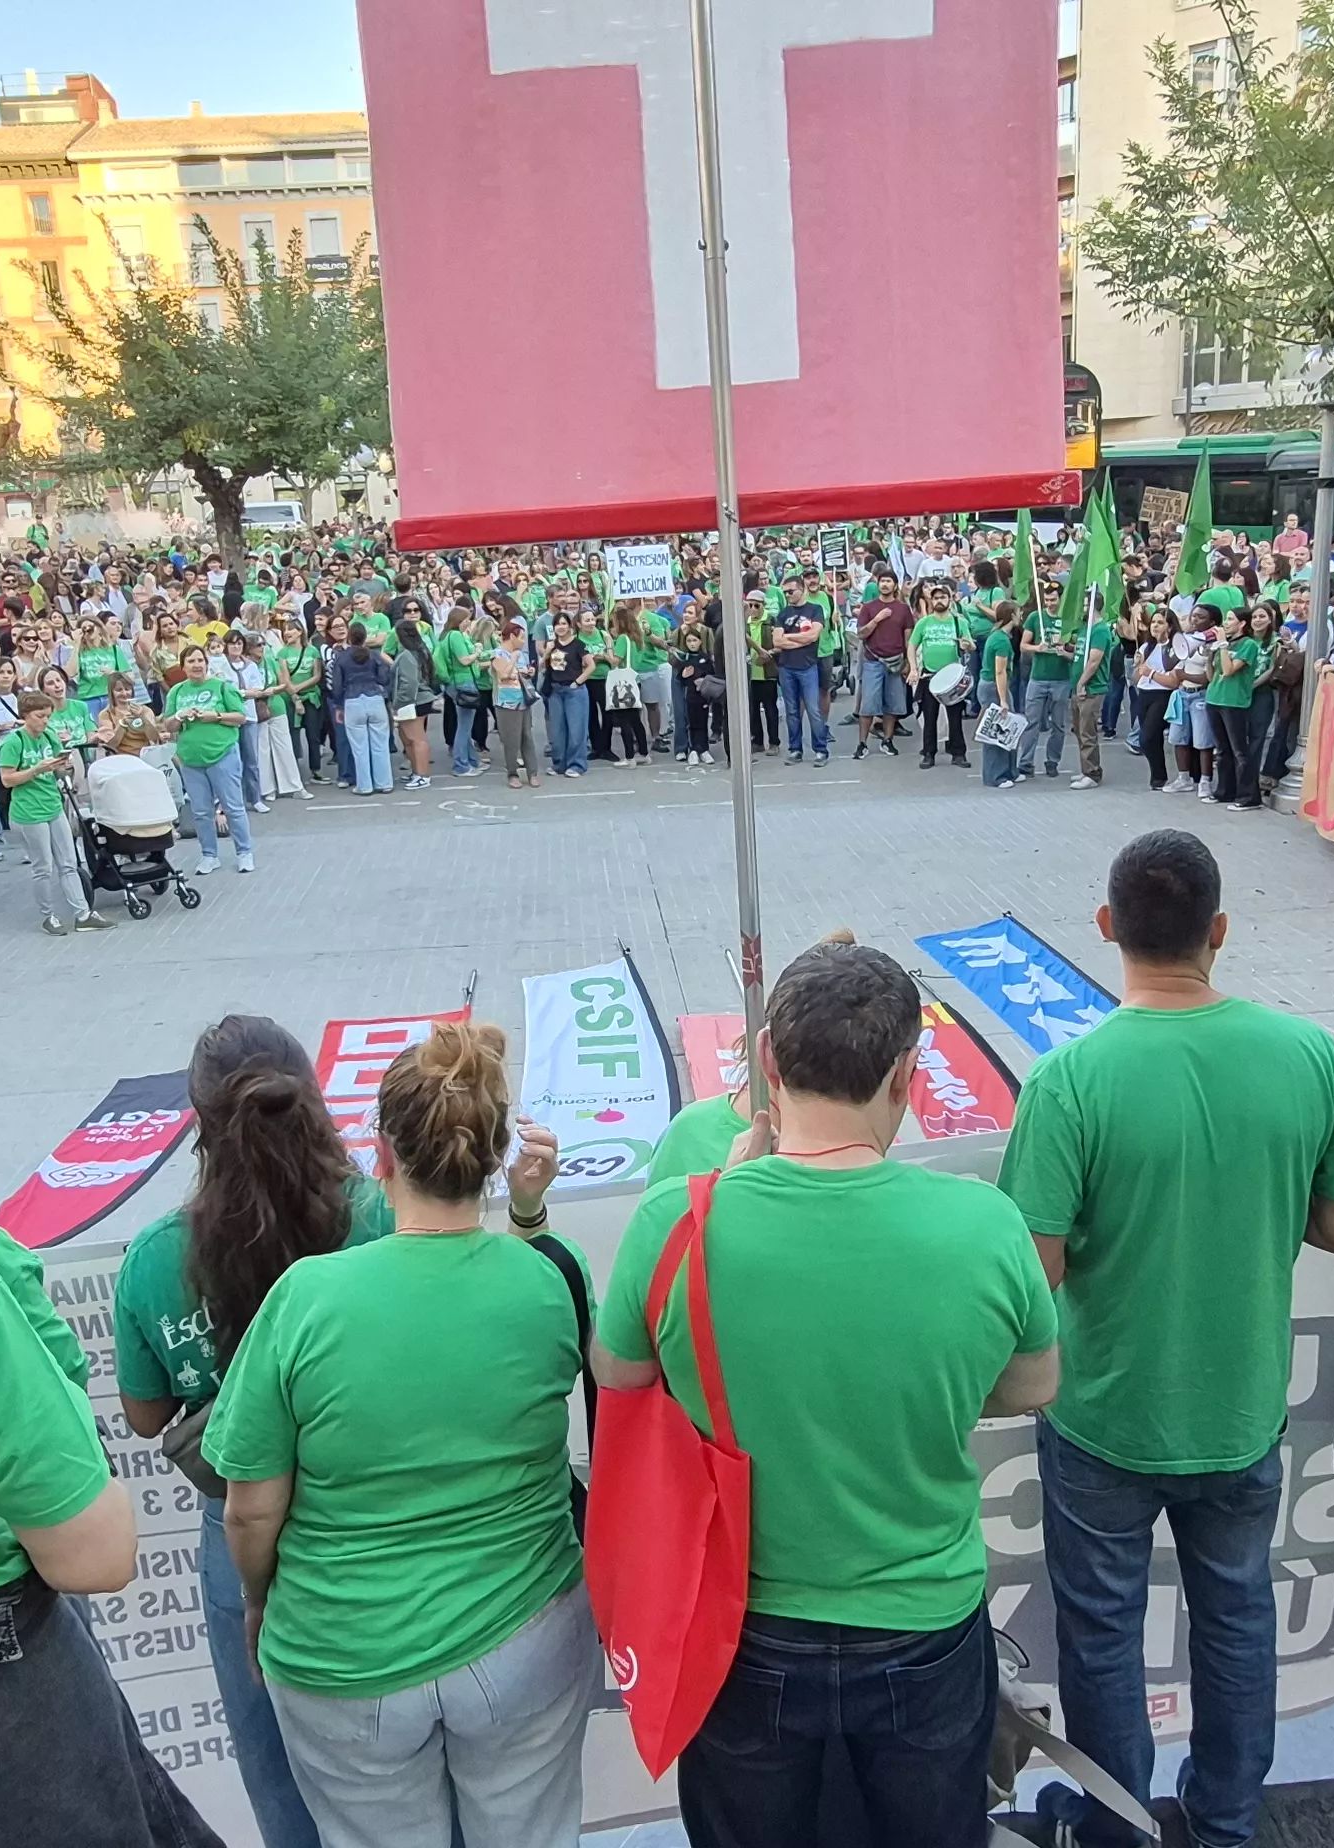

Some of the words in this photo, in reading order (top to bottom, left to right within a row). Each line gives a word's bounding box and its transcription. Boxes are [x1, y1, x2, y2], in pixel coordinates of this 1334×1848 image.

[618, 573, 668, 593] EDUCACIÓN
[570, 976, 641, 1079] CSIF
[86, 1109, 181, 1128] CGT
